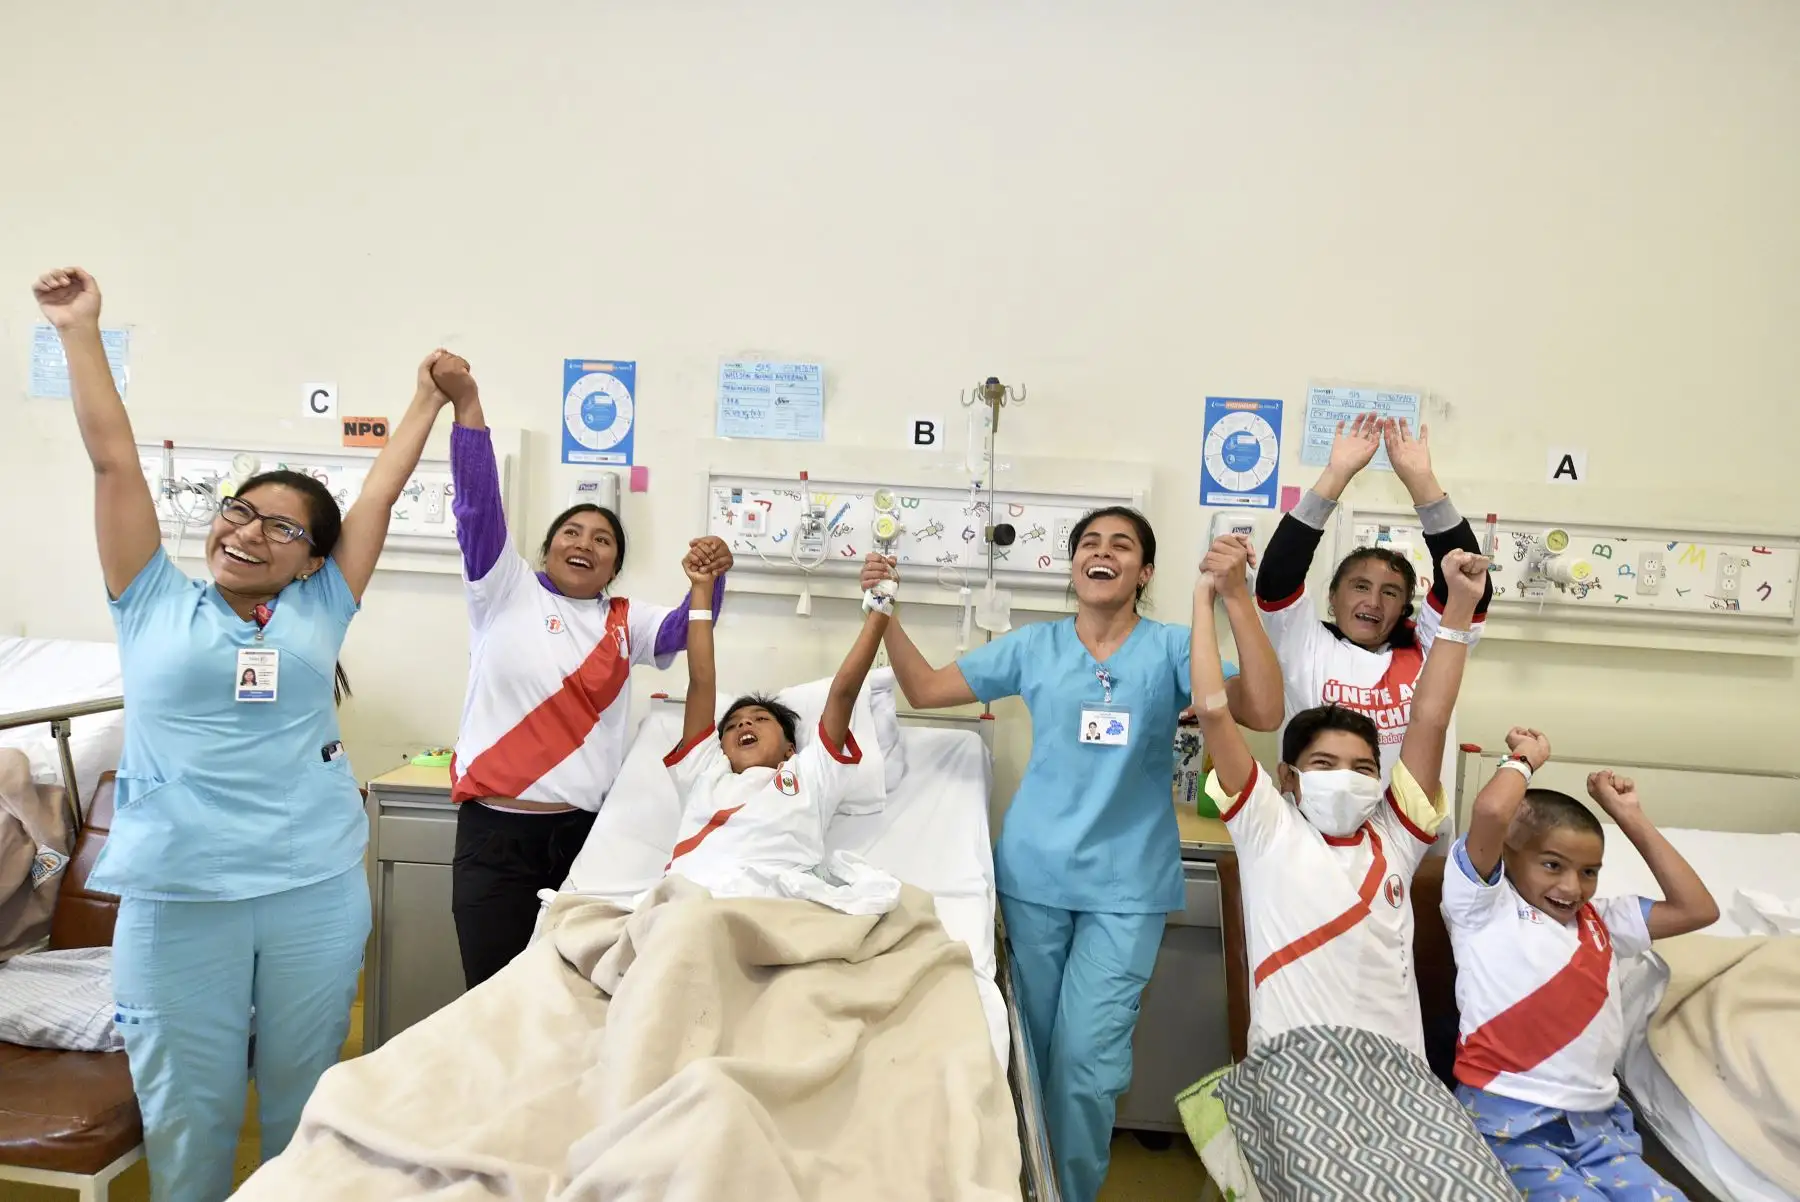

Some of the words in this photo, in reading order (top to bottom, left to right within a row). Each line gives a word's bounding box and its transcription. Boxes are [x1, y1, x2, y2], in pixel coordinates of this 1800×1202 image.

[310, 389, 330, 414] C
[343, 422, 386, 437] NPO
[914, 420, 935, 445] B
[1553, 453, 1578, 480] A
[1592, 543, 1613, 560] B
[1325, 679, 1393, 705] ÚNETE
[1377, 731, 1404, 745] dader
